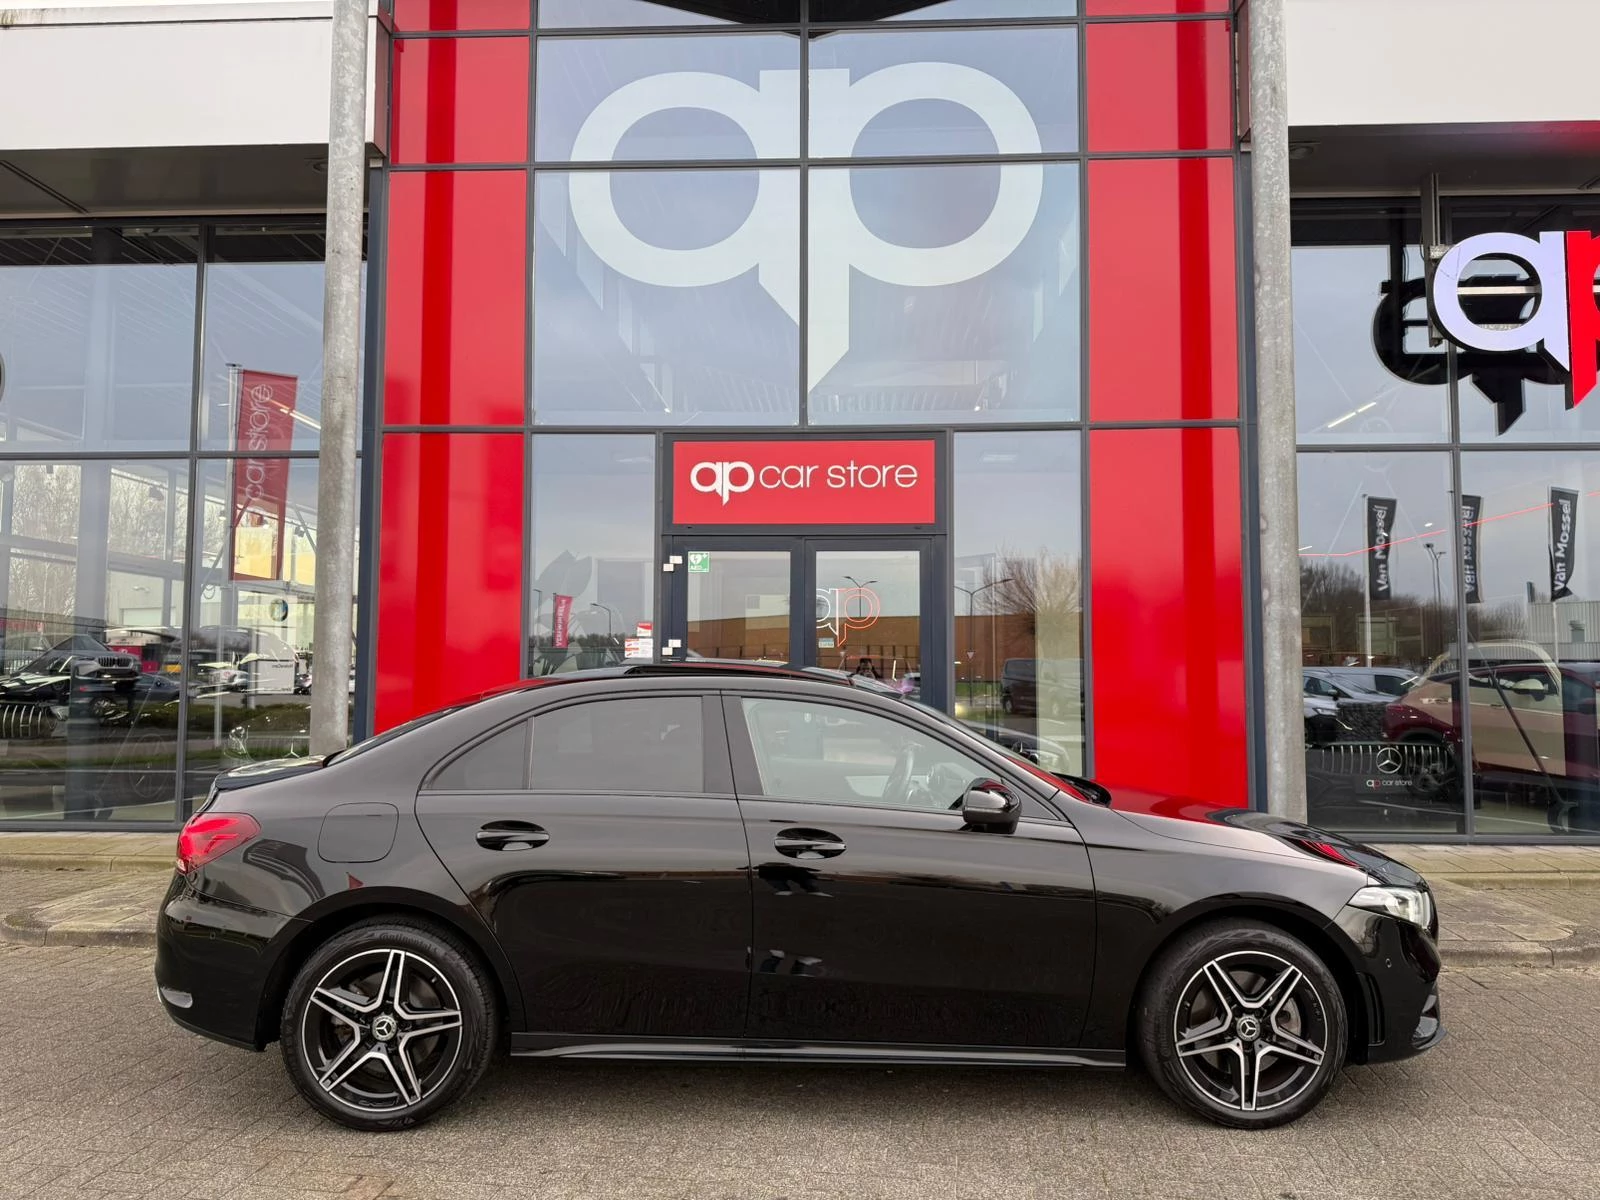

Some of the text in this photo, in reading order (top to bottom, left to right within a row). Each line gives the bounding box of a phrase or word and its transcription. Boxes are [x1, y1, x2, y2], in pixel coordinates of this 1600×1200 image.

[690, 460, 918, 506] ap car store
[1373, 504, 1389, 592] Van Mossel
[1553, 498, 1571, 592] Van Mossel
